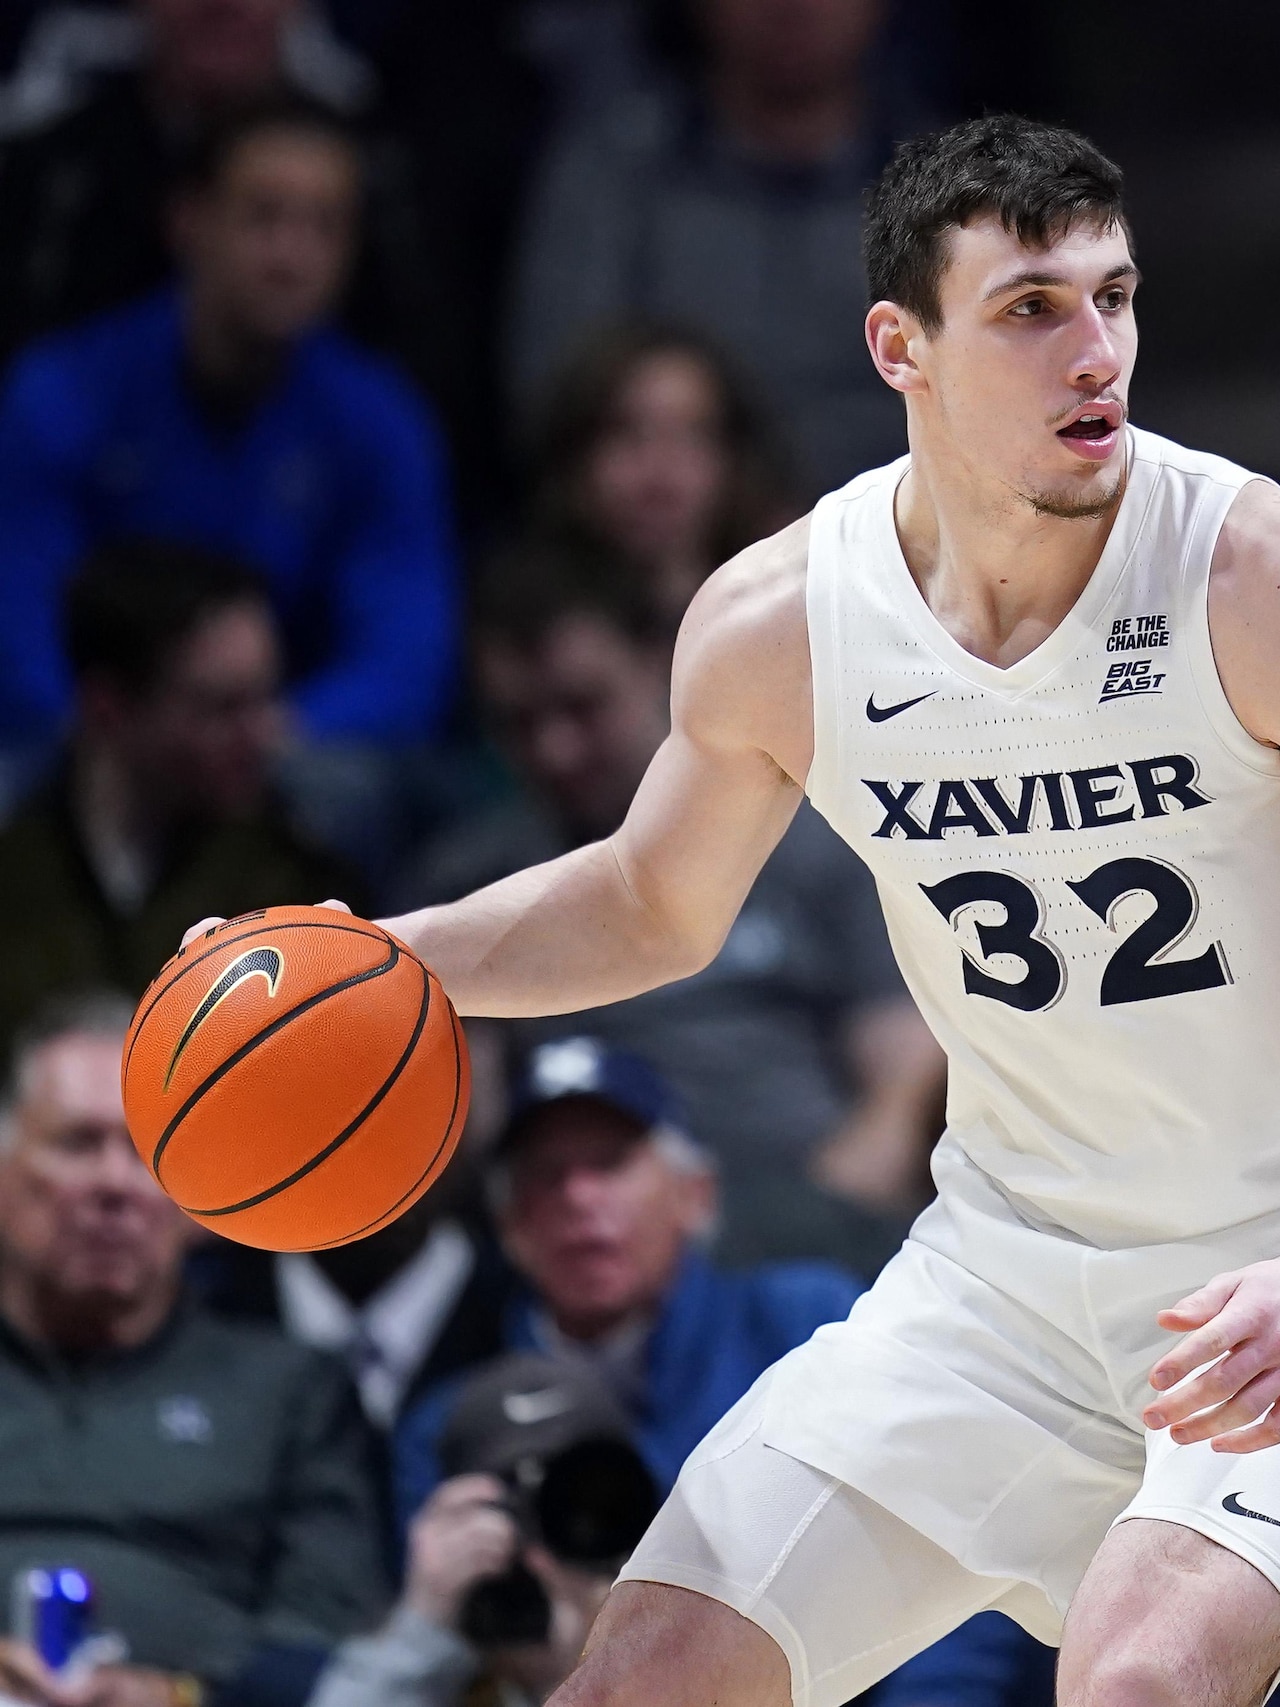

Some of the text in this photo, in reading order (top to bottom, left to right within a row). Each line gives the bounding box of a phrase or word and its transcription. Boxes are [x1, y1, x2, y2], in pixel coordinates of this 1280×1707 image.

[1111, 614, 1167, 636] BE THE
[1106, 631, 1170, 652] CHANGE
[1106, 659, 1152, 679] BIG
[1101, 673, 1167, 694] EAST
[860, 753, 1216, 840] XAVIER
[918, 855, 1234, 1012] 32
